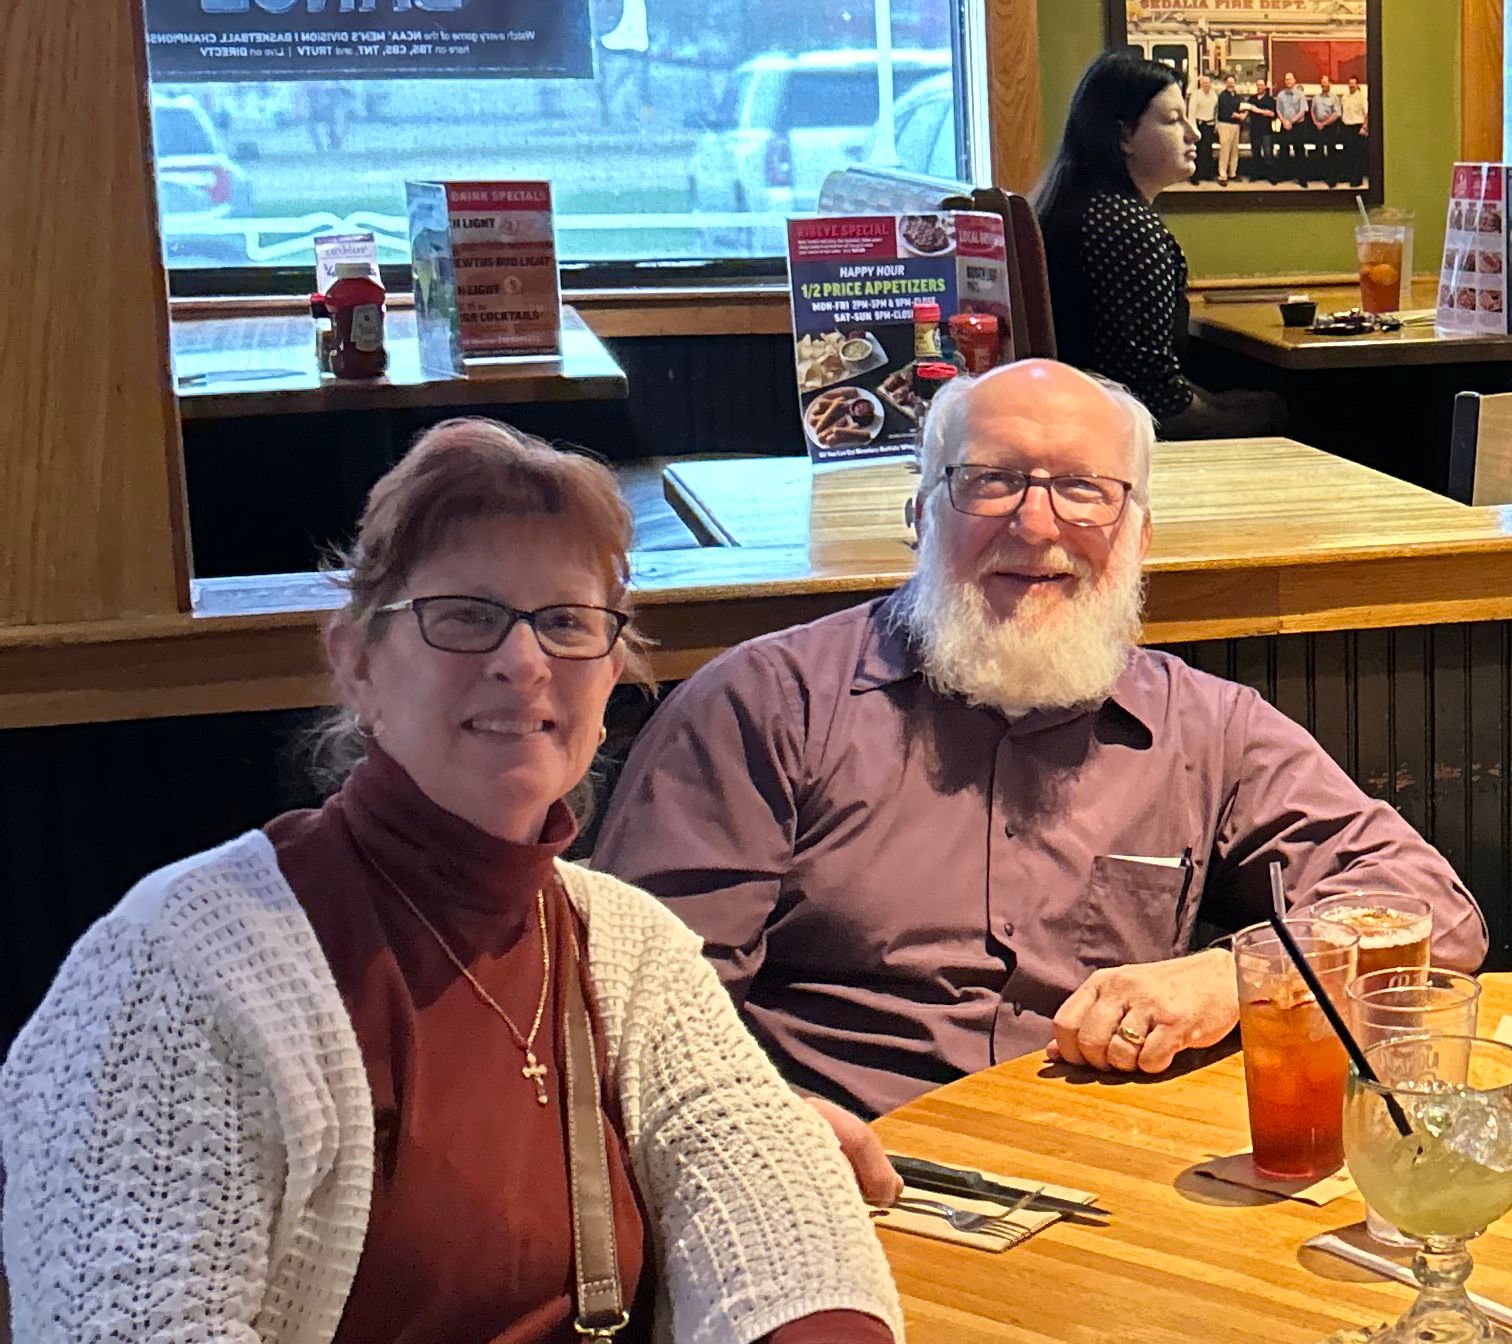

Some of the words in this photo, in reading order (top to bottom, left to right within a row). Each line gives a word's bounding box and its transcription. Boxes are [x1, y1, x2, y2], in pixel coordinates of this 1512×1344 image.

[1139, 0, 1209, 10] SEDALIA
[1214, 0, 1253, 10] FIRE
[1259, 0, 1308, 10] DEPT.
[450, 190, 489, 202] DRINK
[462, 217, 495, 229] LIGHT
[842, 223, 889, 237] SPECIAL
[520, 256, 550, 268] LIGHT
[840, 266, 875, 279] HAPPY
[877, 264, 905, 276] HOUR
[801, 281, 822, 299] 1/2
[823, 280, 863, 298] PRICE
[864, 278, 946, 296] APPETIZERS
[812, 300, 850, 312] MON-FRI
[834, 312, 872, 323] SAT-SUN
